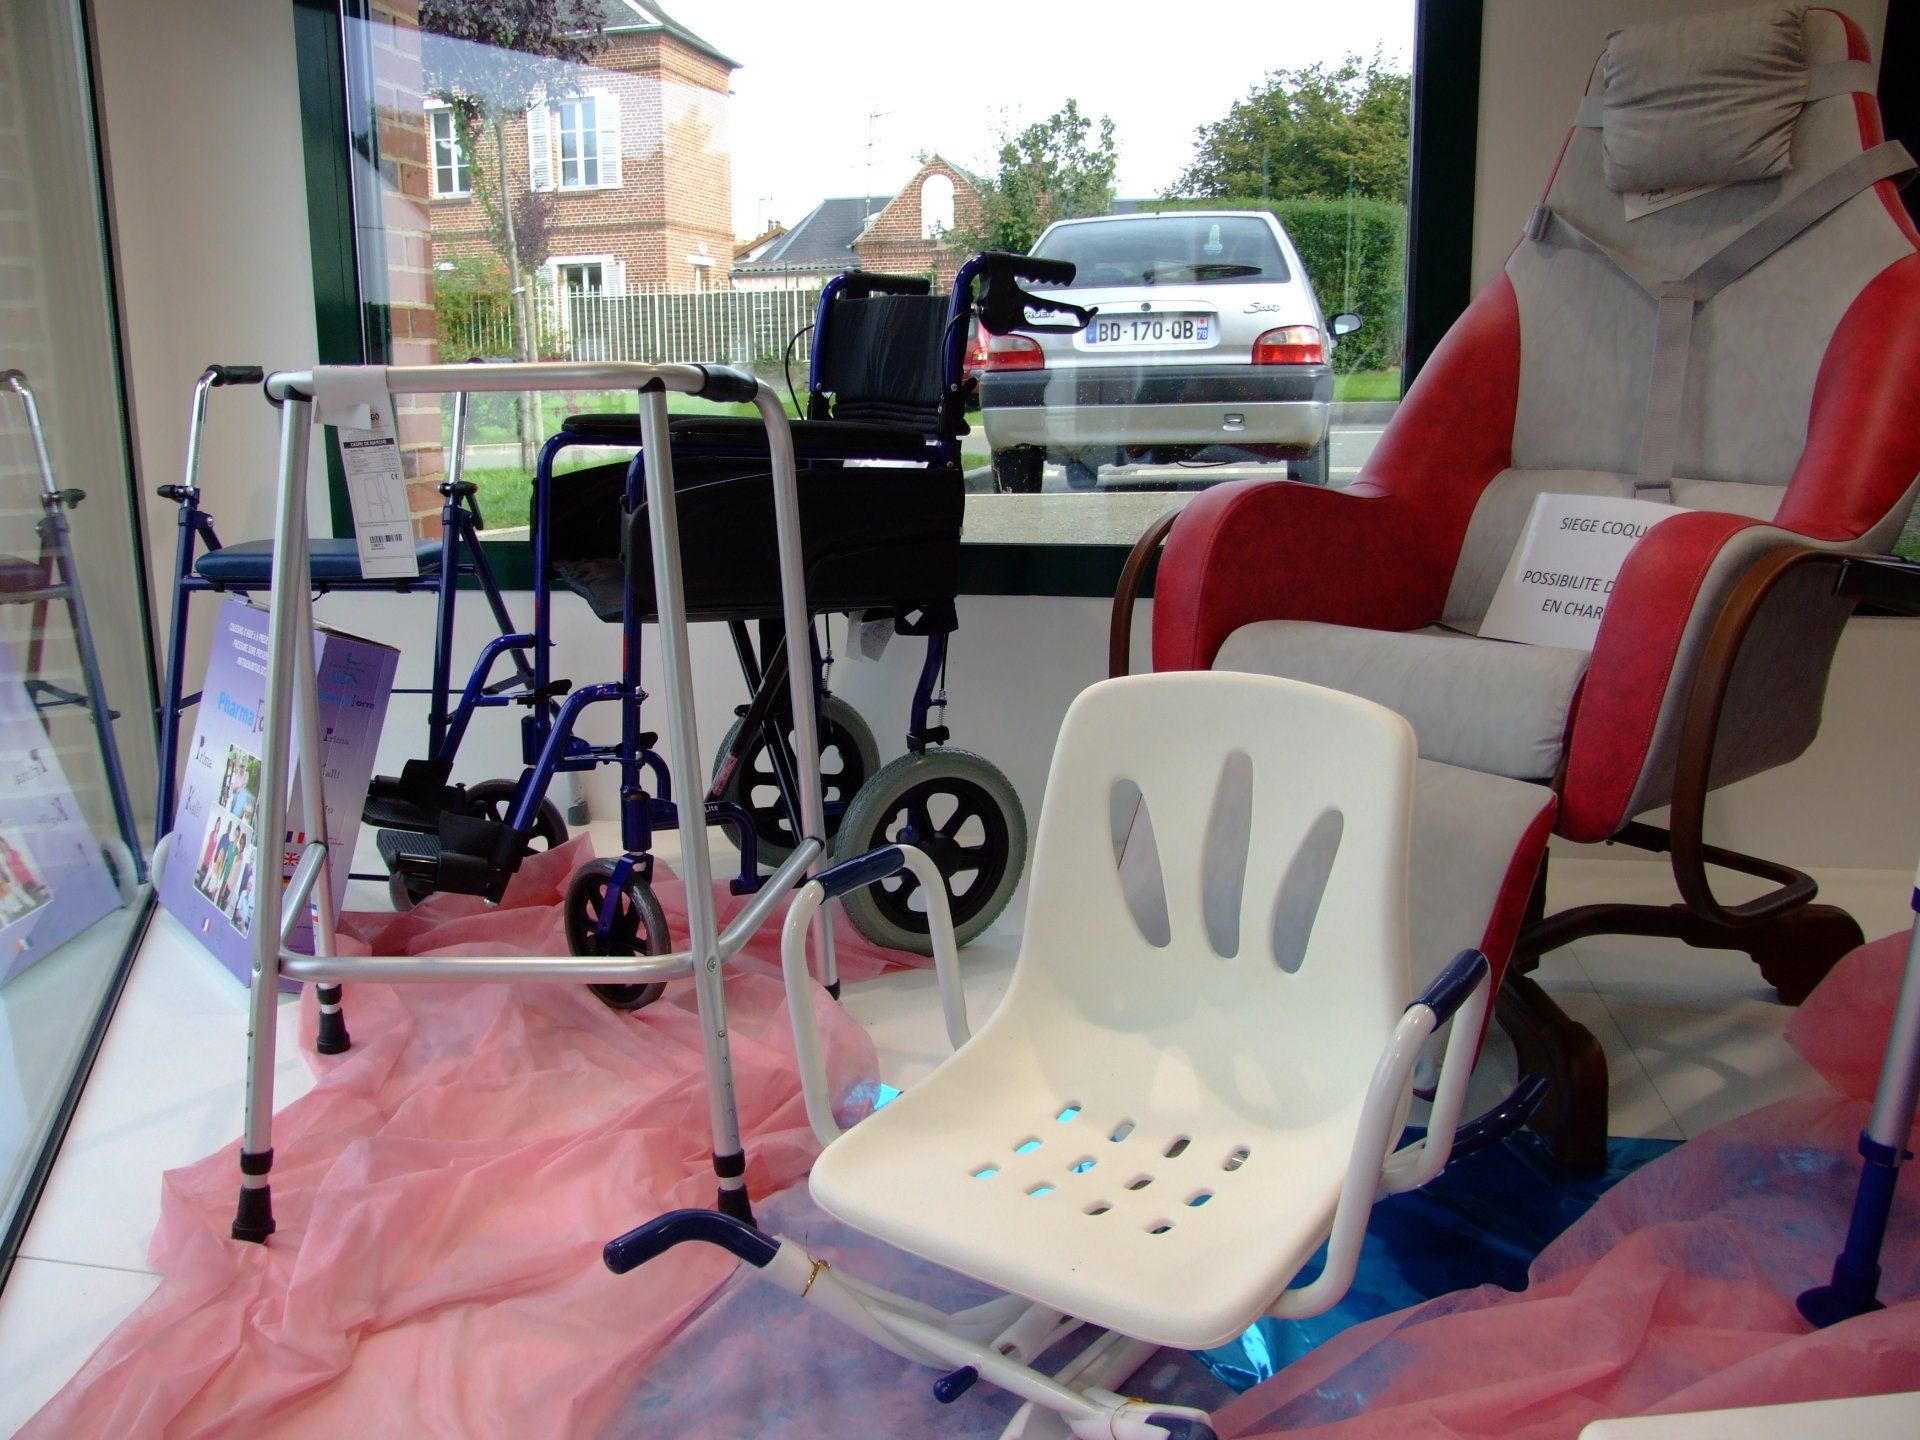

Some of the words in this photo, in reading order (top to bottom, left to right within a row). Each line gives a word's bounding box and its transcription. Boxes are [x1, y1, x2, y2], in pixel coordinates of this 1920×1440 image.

[1098, 320, 1193, 342] BD-170-QB
[1559, 517, 1600, 533] SIEGE
[1601, 520, 1649, 538] COQU
[1523, 570, 1602, 592] POSSIBILITE
[1604, 580, 1616, 594] D
[1541, 598, 1563, 614] EN
[1564, 601, 1604, 620] CHAR
[217, 690, 265, 733] PharmaFo
